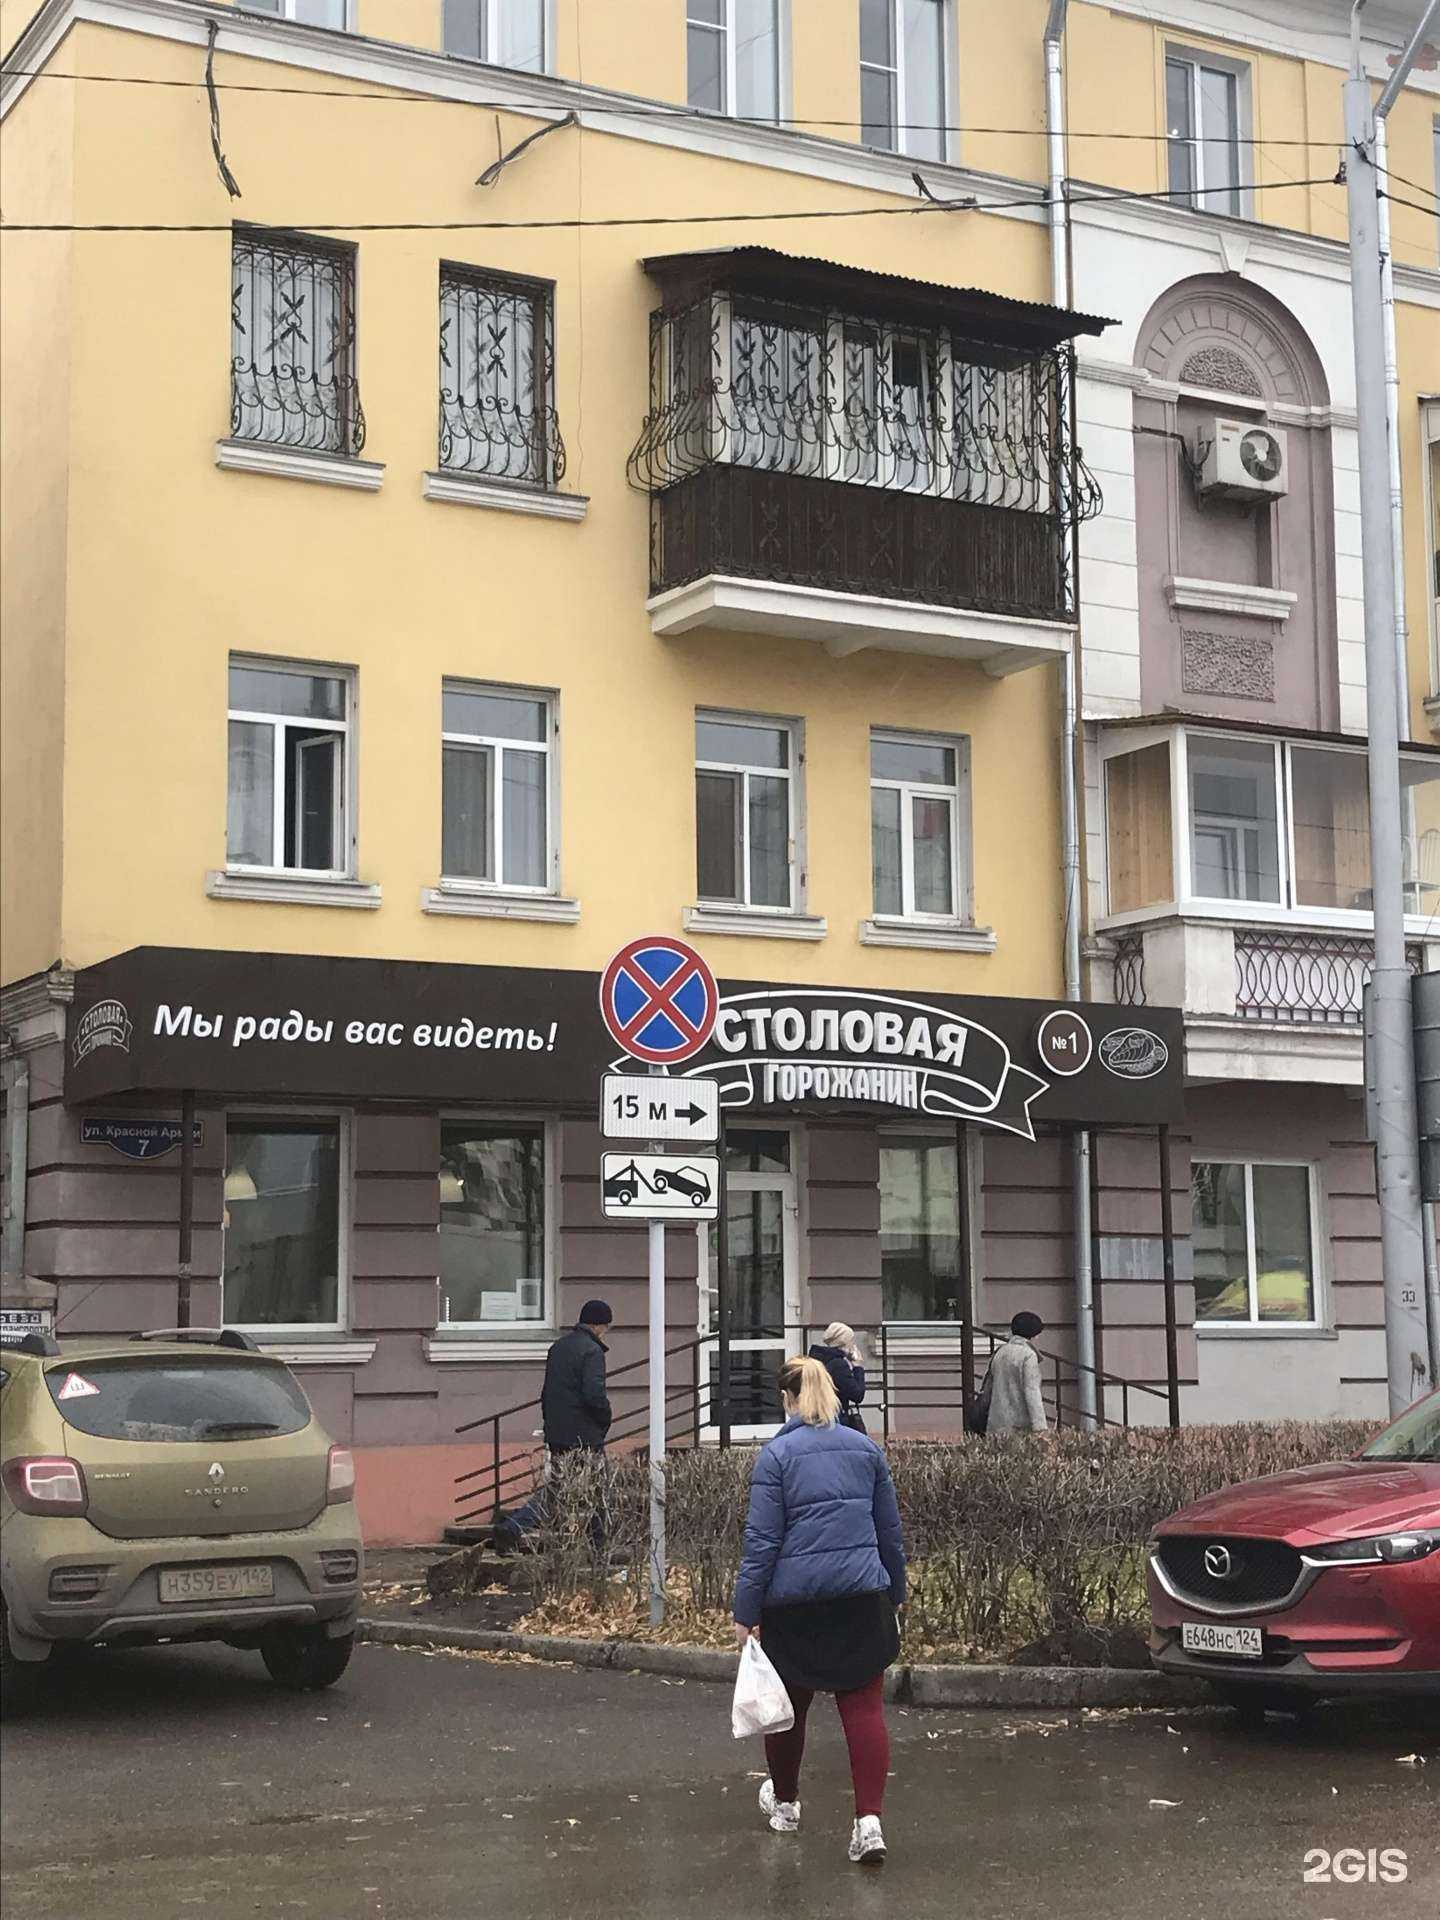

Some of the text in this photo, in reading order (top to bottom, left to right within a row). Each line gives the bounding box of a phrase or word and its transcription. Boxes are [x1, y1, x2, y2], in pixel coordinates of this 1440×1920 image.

[153, 1004, 558, 1052] Мы рады вас видеть!
[713, 1007, 968, 1067] СТОЛОВАЯ
[763, 1063, 918, 1110] ГОРОЖАНИН
[612, 1094, 639, 1120] 15
[84, 1126, 103, 1138] ул.
[106, 1125, 158, 1138] Красной
[138, 1139, 150, 1156] 7
[1401, 1290, 1416, 1303] 33
[184, 1486, 249, 1497] SANDERO
